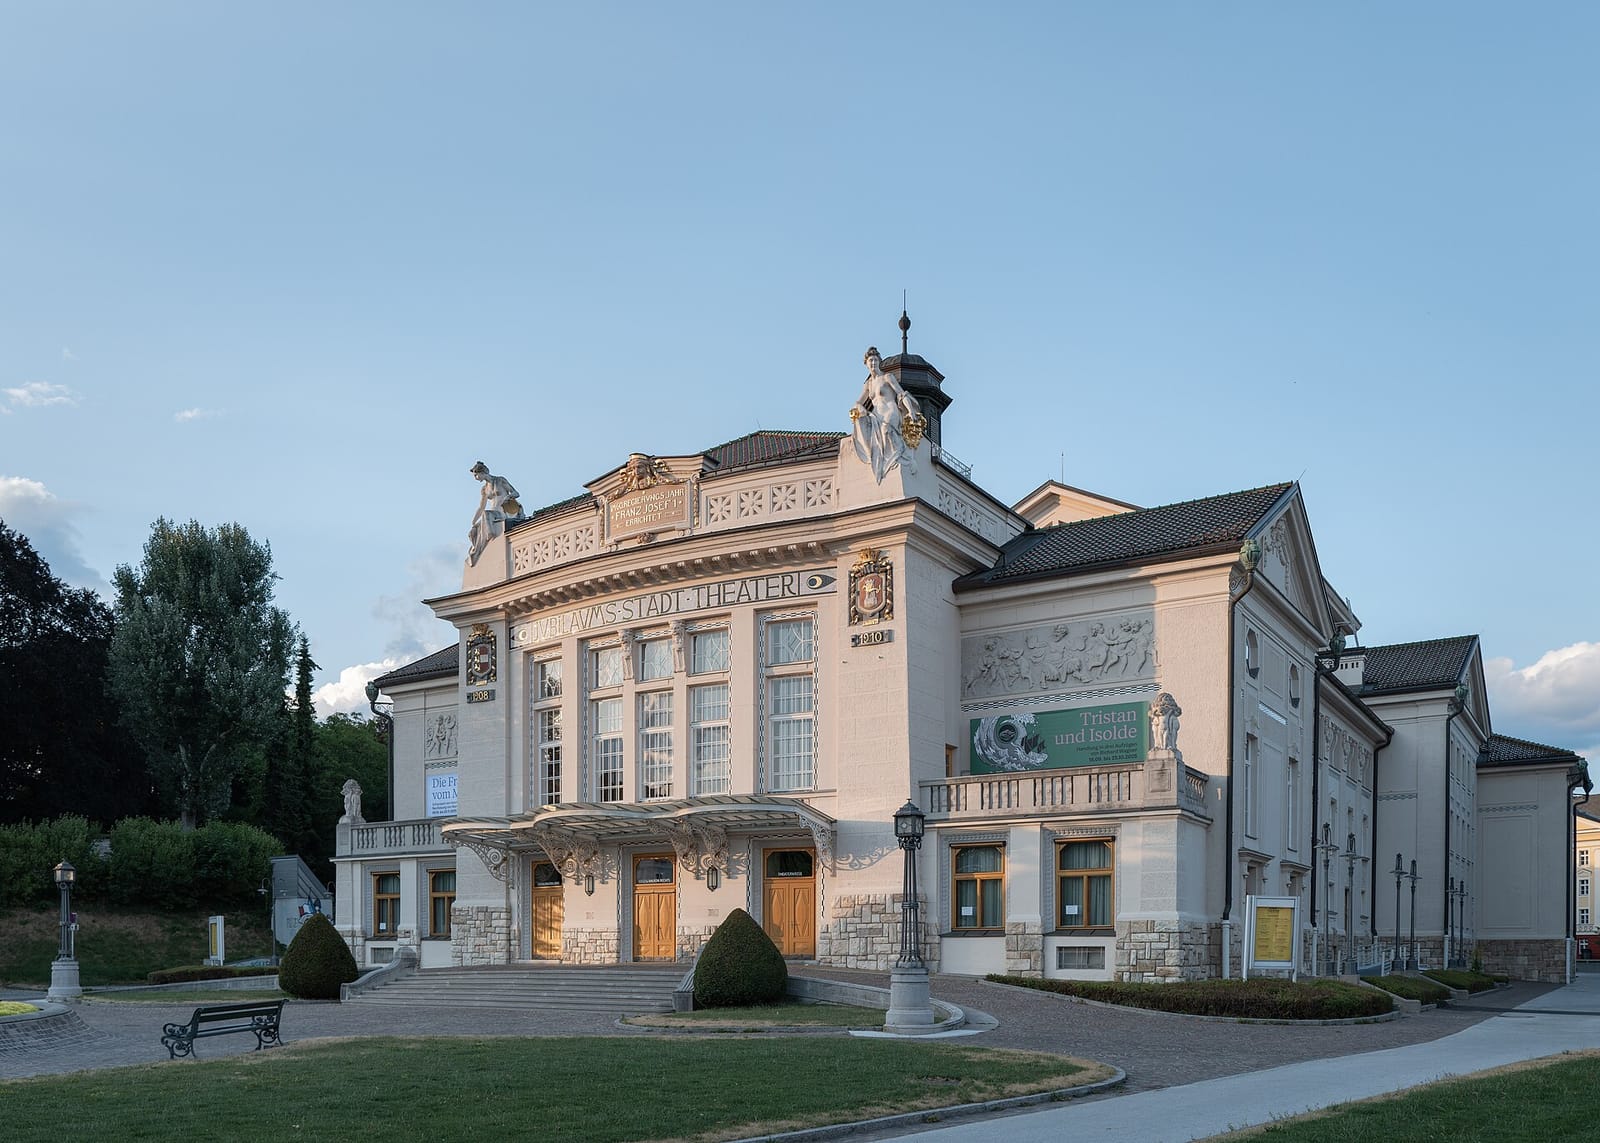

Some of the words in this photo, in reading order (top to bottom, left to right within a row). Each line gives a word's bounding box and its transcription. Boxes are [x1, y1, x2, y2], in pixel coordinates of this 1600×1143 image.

[615, 506, 642, 521] FRANZ
[643, 500, 669, 514] JOSEF
[692, 575, 797, 608] THEATER
[1080, 710, 1137, 726] Tristan
[1055, 728, 1085, 745] und
[1089, 725, 1137, 742] Isolde
[432, 777, 447, 788] Die
[432, 791, 451, 800] vom
